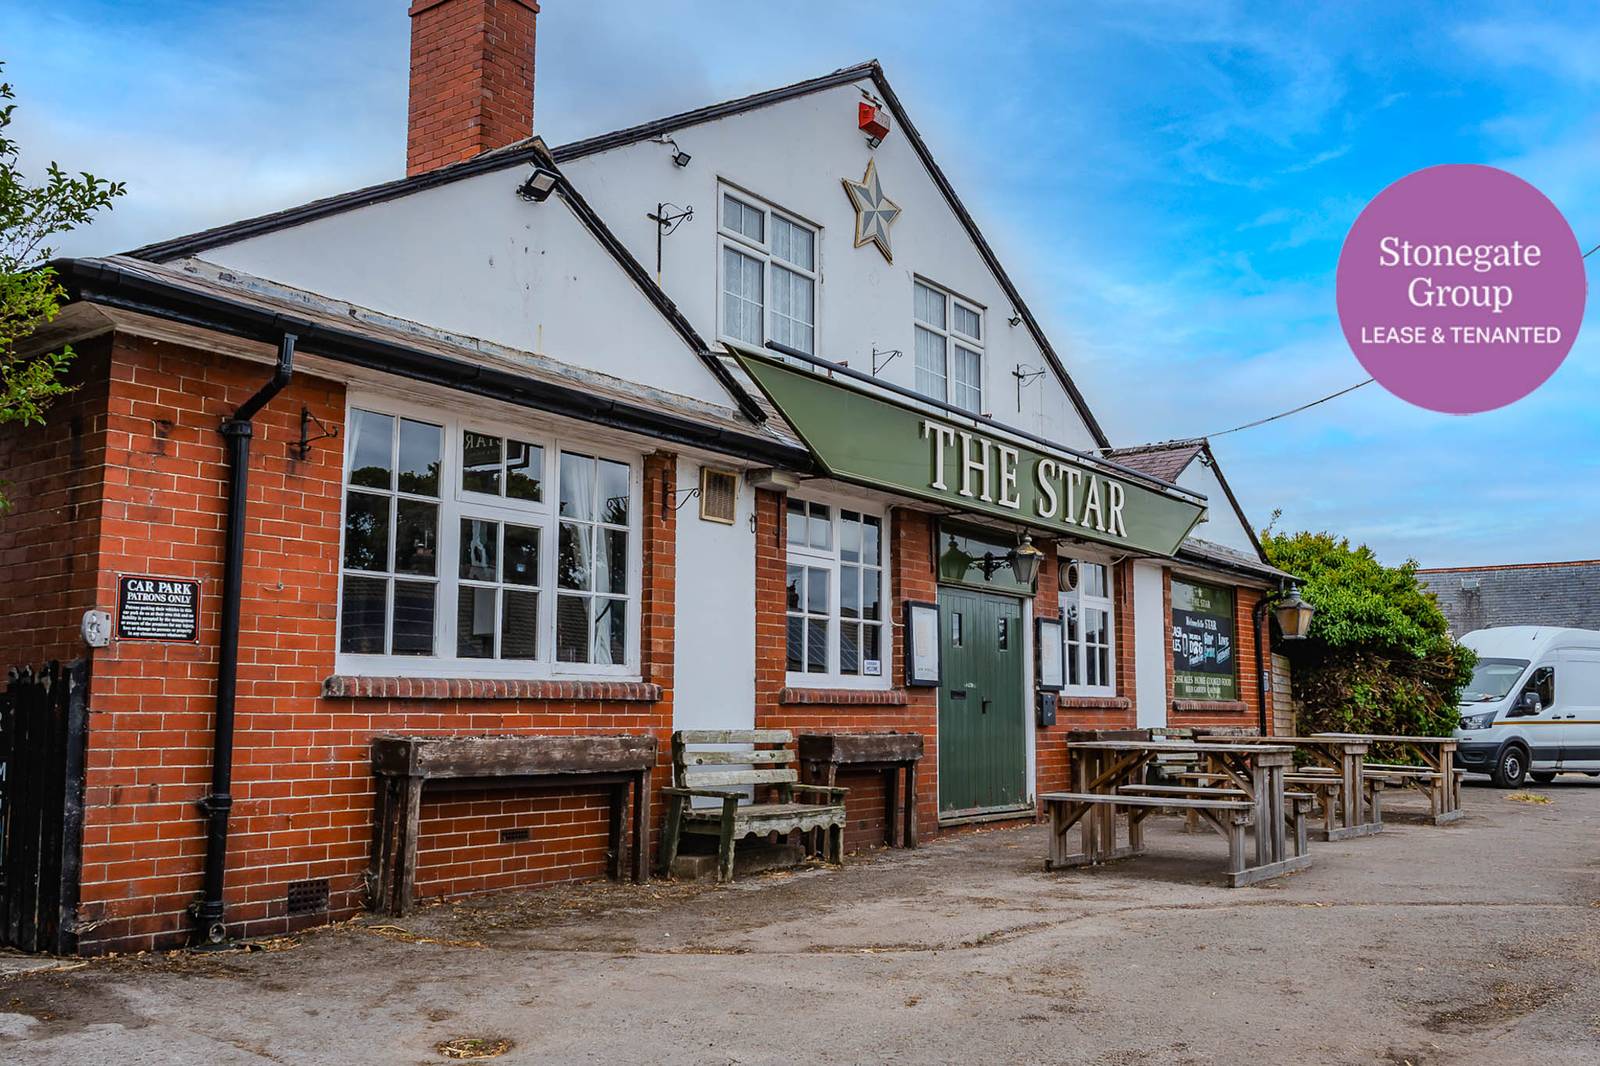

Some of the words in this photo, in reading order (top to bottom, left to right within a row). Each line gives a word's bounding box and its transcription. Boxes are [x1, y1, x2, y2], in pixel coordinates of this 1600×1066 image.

[924, 420, 1020, 509] THE
[1038, 458, 1128, 538] STAR
[127, 580, 154, 593] CAR
[158, 582, 192, 595] PARK
[127, 592, 167, 602] PATRONS
[168, 595, 192, 604] ONLY
